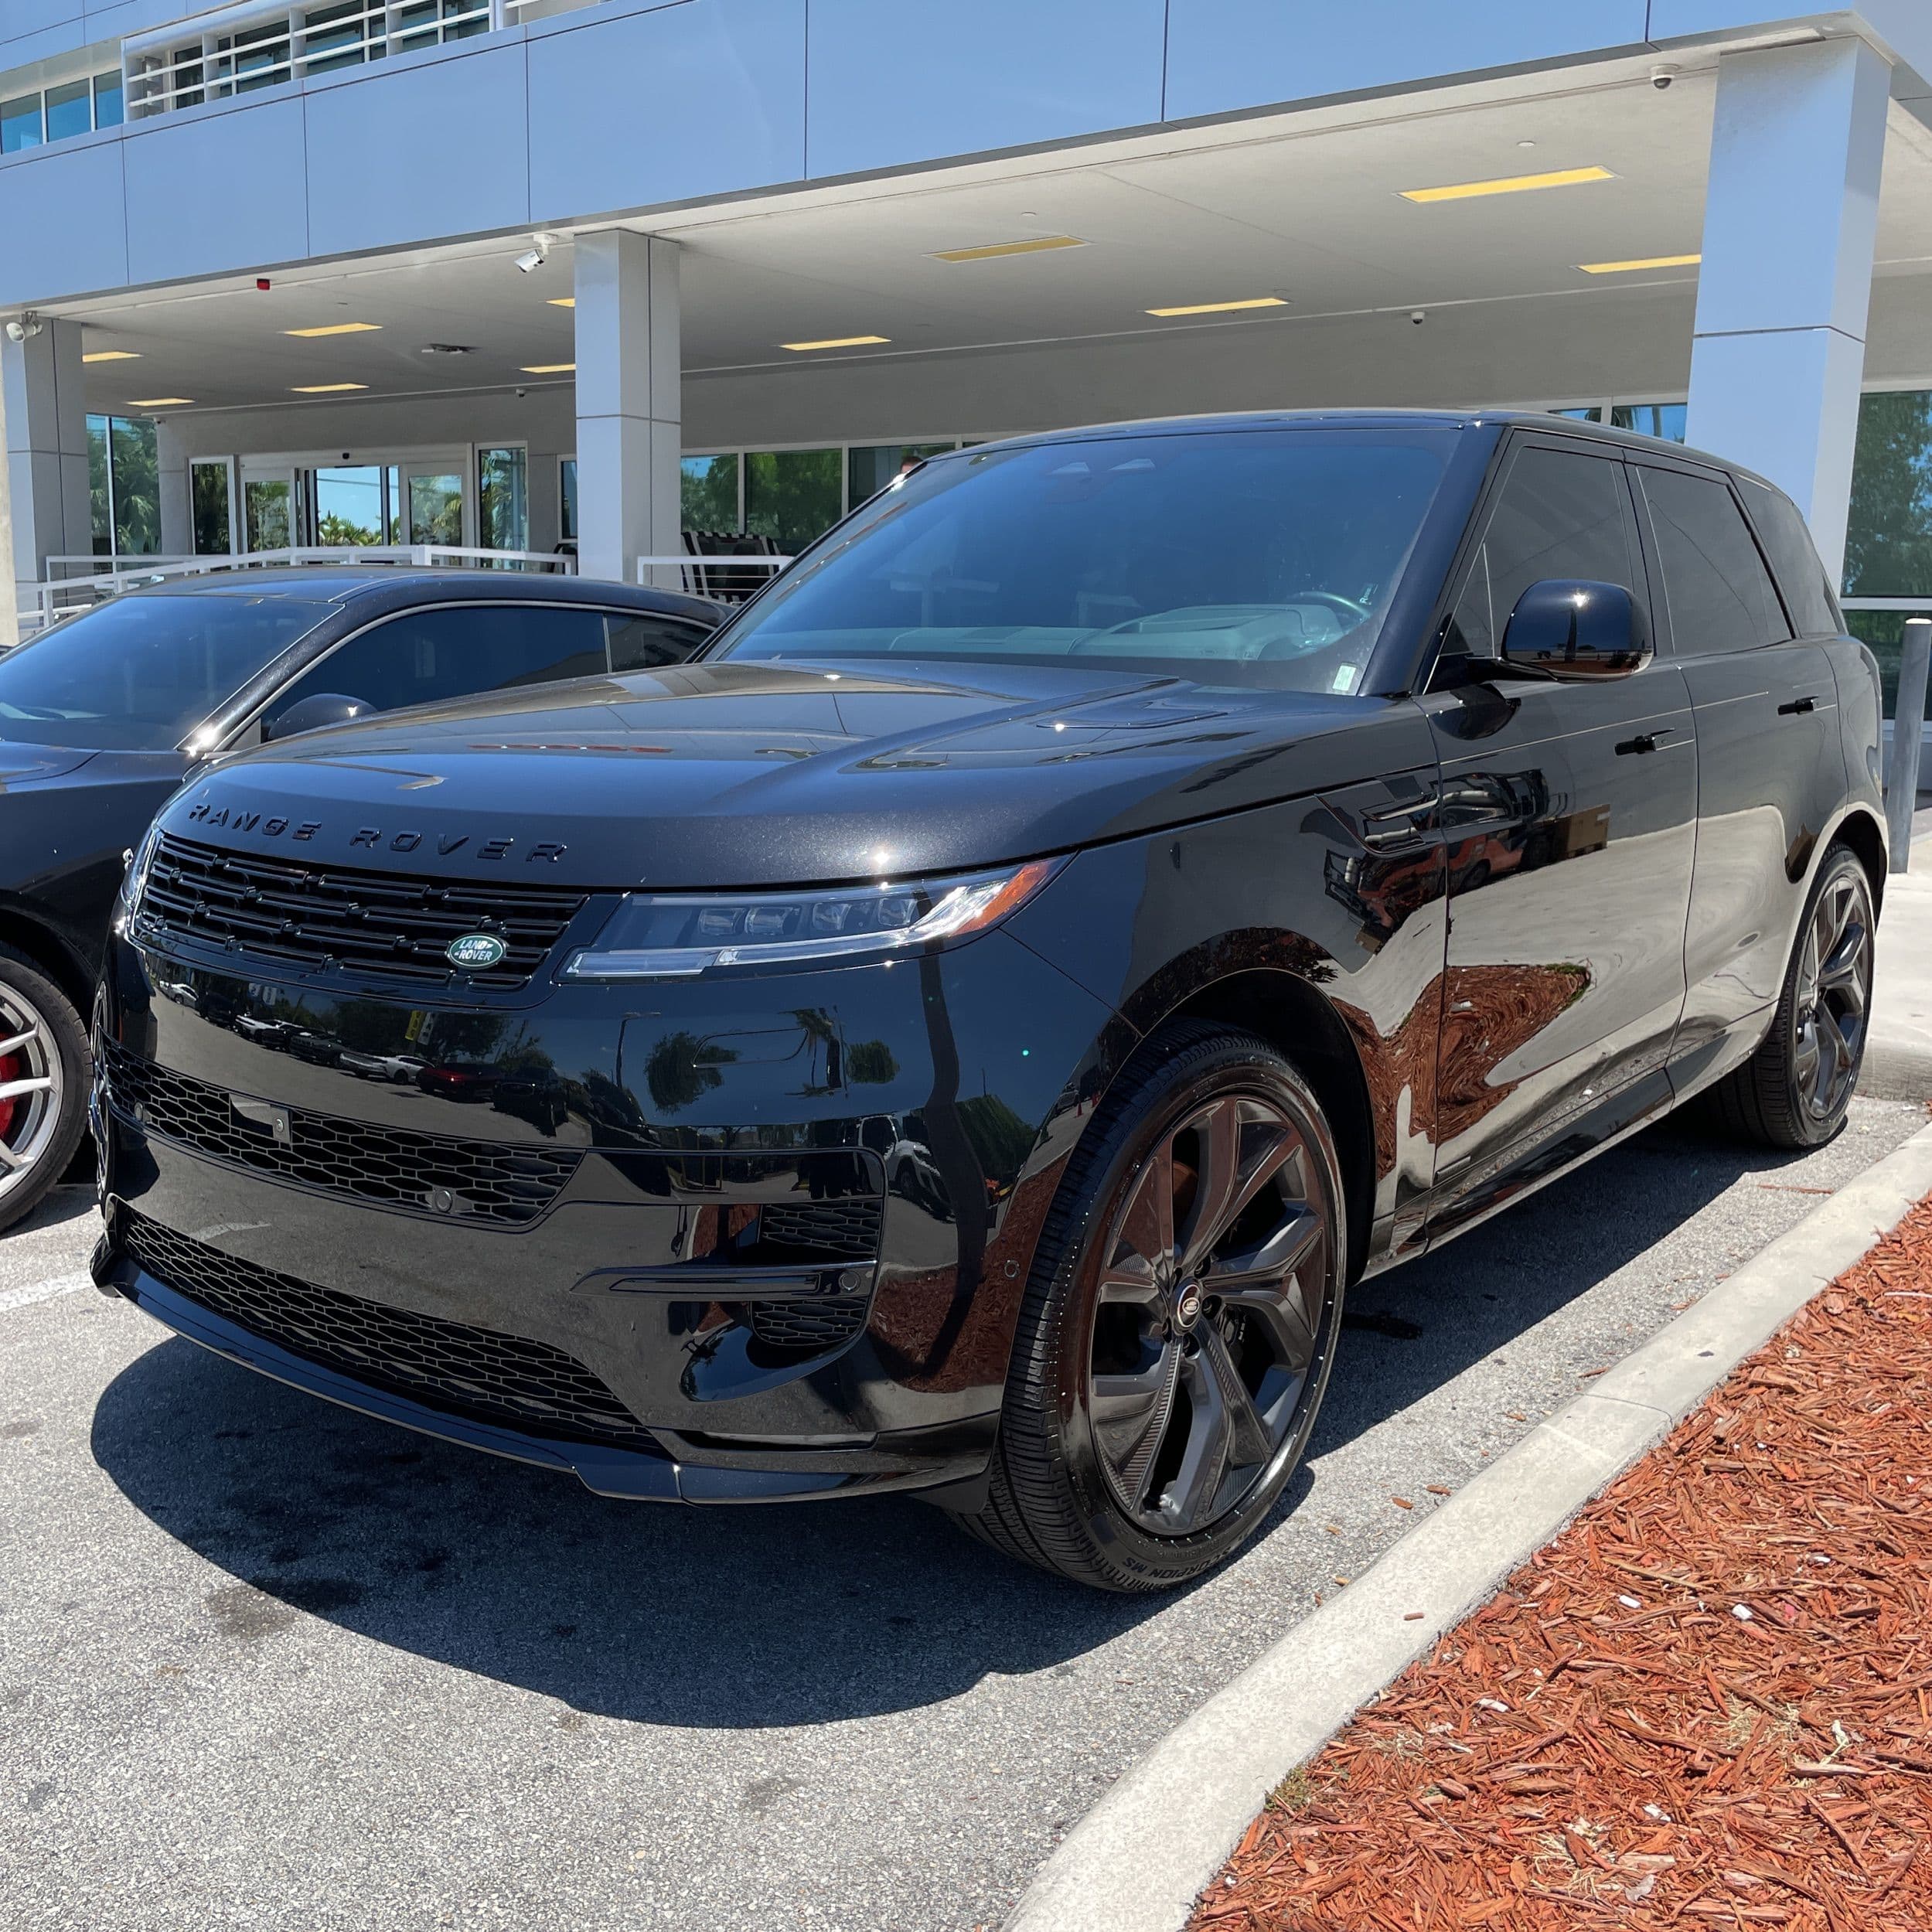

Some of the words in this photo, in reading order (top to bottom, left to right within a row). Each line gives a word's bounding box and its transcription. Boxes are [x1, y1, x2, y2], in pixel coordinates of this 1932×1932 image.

[189, 804, 322, 841] RANGE
[349, 826, 567, 863] ROVER
[458, 939, 489, 950] LAND
[458, 949, 493, 961] ROVER
[1123, 1556, 1149, 1574] MS
